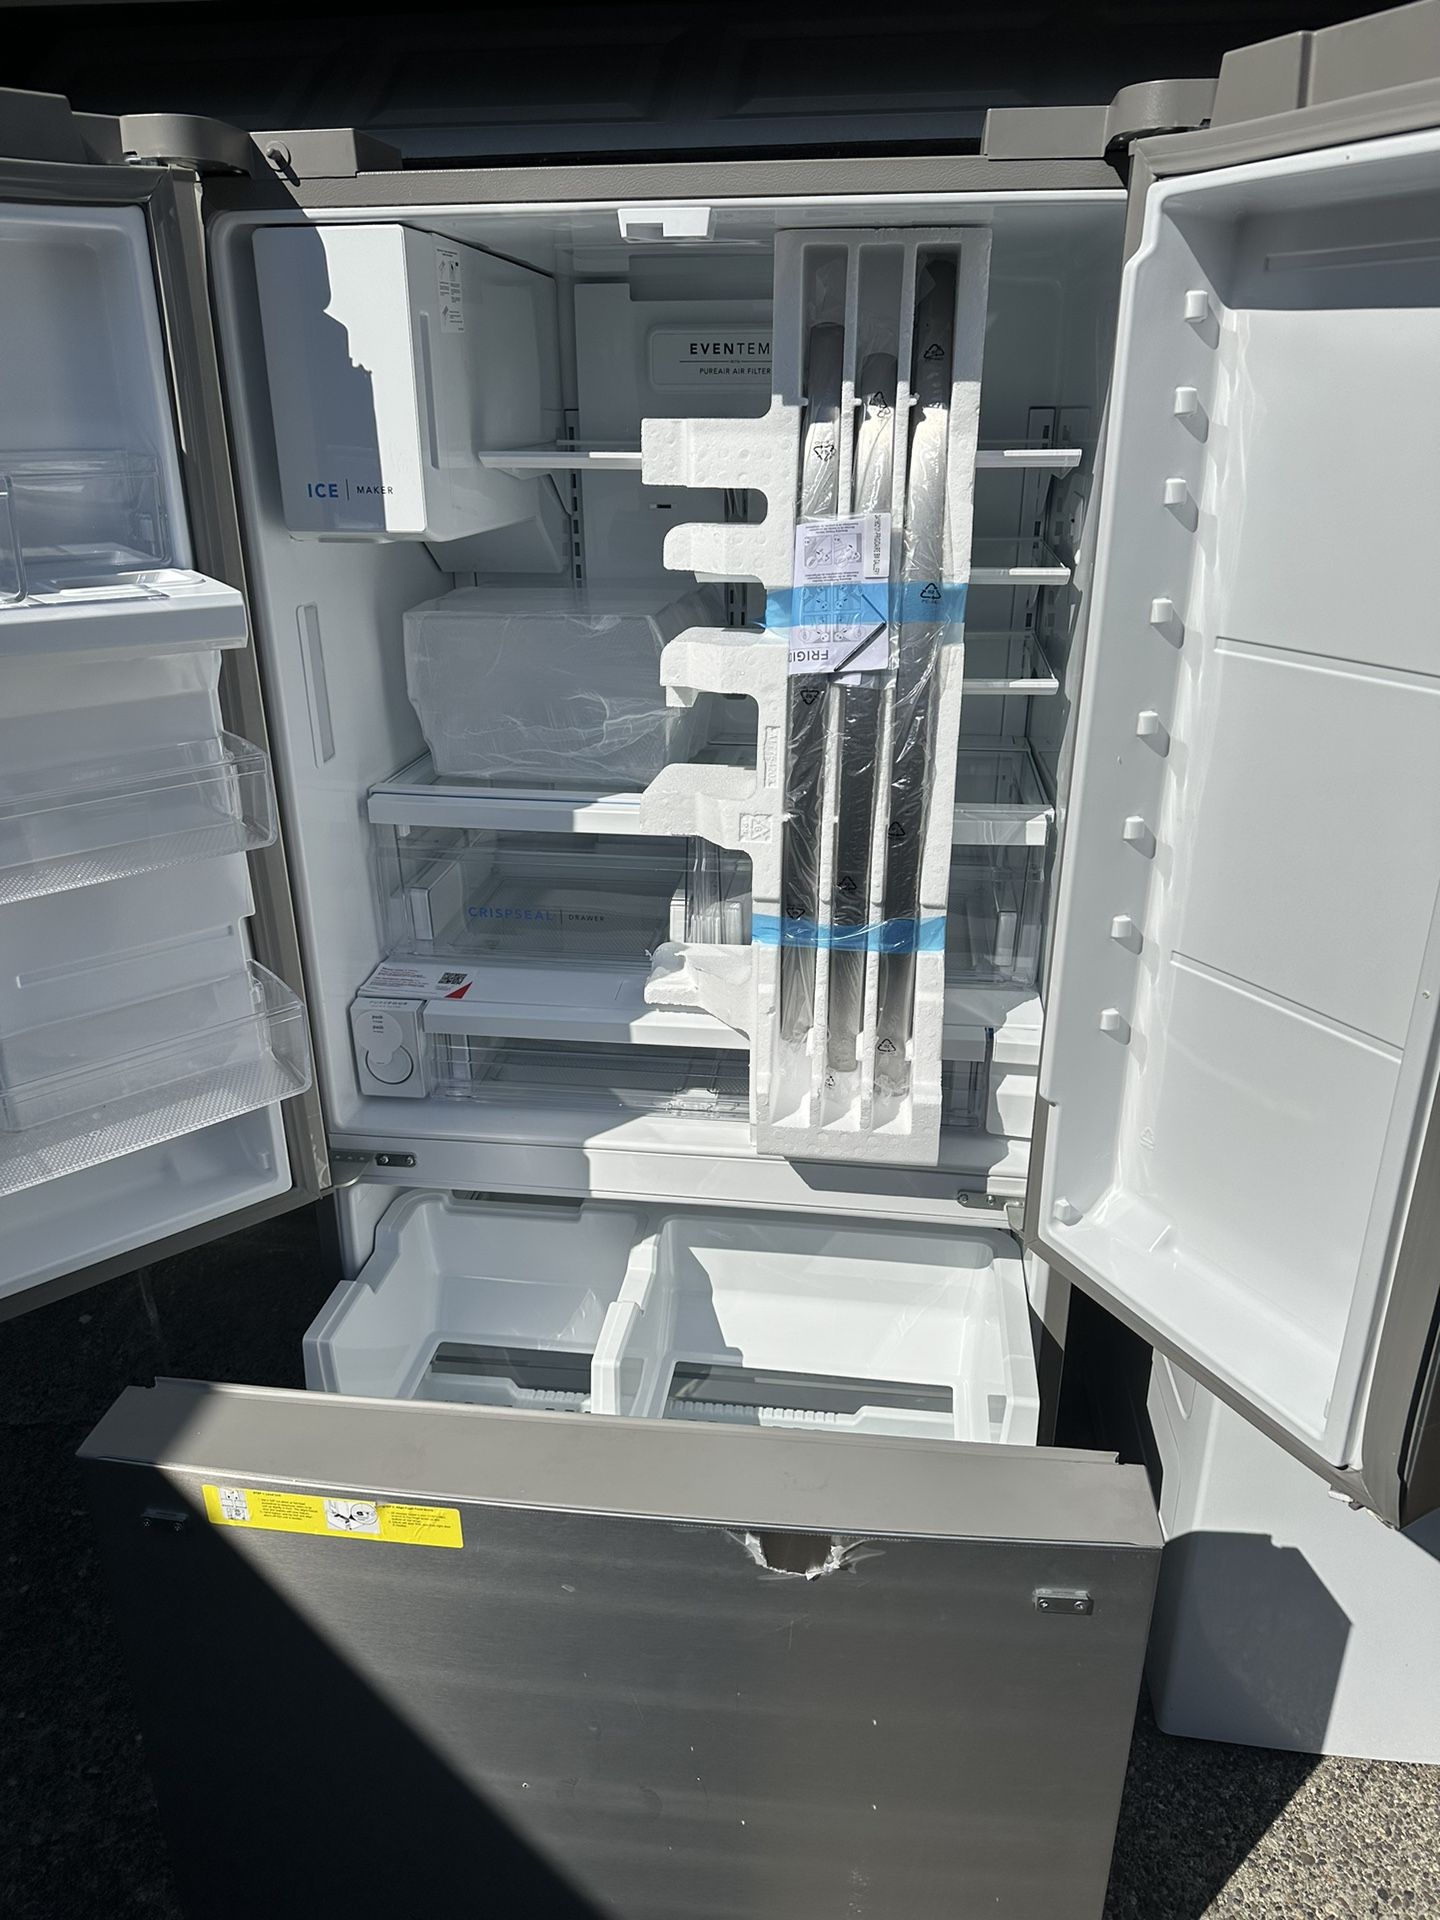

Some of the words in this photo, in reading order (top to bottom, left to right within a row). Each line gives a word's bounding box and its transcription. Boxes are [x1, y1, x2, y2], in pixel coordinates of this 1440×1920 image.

[689, 343, 770, 355] EVENTEM
[308, 483, 339, 498] ICE
[356, 486, 393, 494] MAKER
[468, 906, 554, 921] CRISPSEAL
[568, 914, 605, 922] DRAWER
